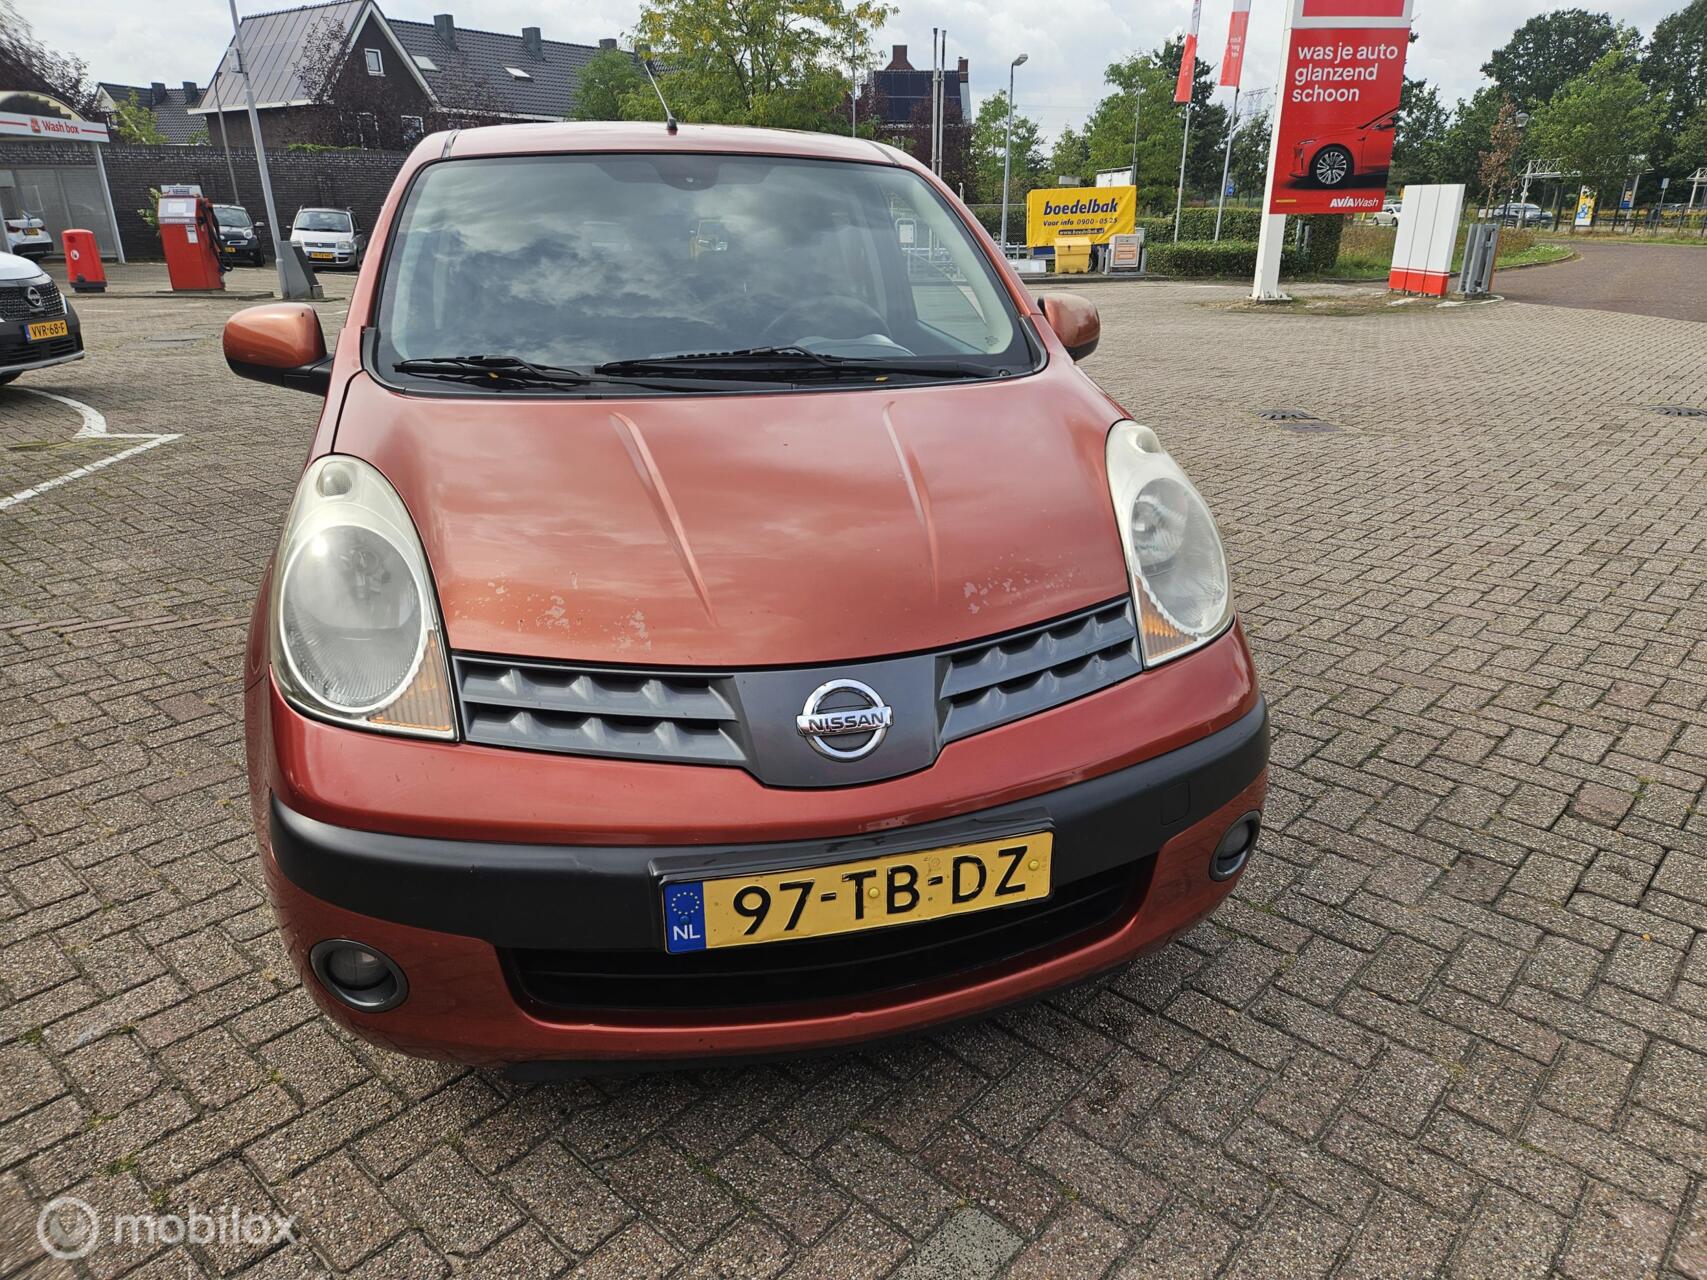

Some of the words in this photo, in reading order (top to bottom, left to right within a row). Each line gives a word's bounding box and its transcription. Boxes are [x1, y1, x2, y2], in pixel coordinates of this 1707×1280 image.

[1298, 46, 1334, 60] was
[1334, 42, 1354, 65] je
[1356, 43, 1399, 60] auto
[1295, 62, 1379, 86] glanzend
[1292, 84, 1360, 102] schoon
[41, 120, 65, 133] Wash
[65, 122, 80, 134] box
[1043, 198, 1119, 216] boedelbak
[1060, 218, 1074, 226] info
[31, 322, 65, 337] VVR-68-F
[808, 711, 884, 733] NISSAN
[732, 845, 1028, 936] 97-TB-DZ
[672, 925, 701, 941] NL
